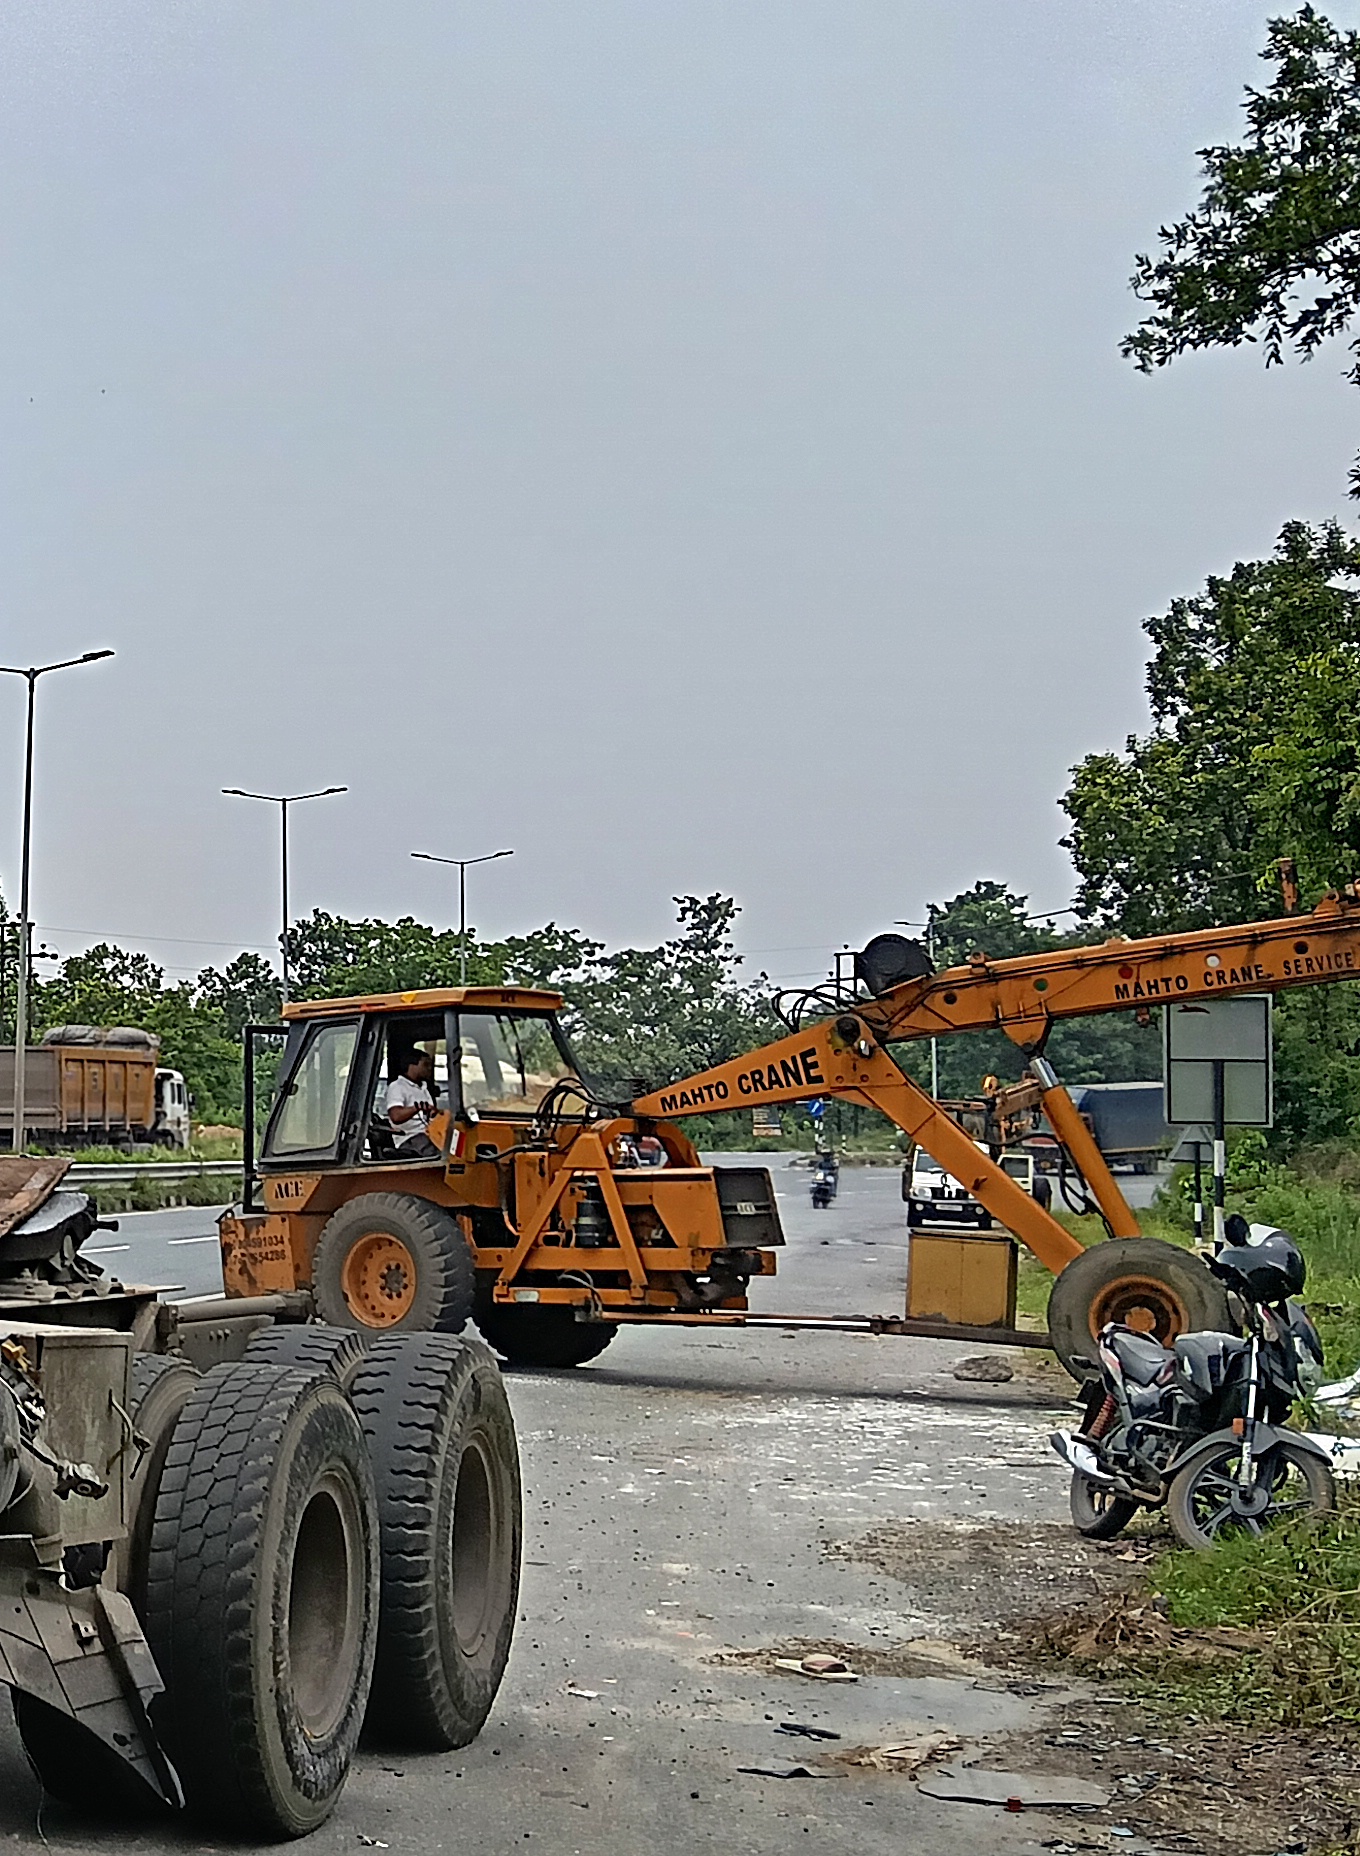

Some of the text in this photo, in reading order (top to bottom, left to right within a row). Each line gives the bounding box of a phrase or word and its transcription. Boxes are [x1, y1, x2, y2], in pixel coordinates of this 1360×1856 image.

[1114, 952, 1355, 1000] MAHTO CRANE SERVICE
[660, 1047, 825, 1112] MAHTO CRANE
[274, 1181, 305, 1199] ACE
